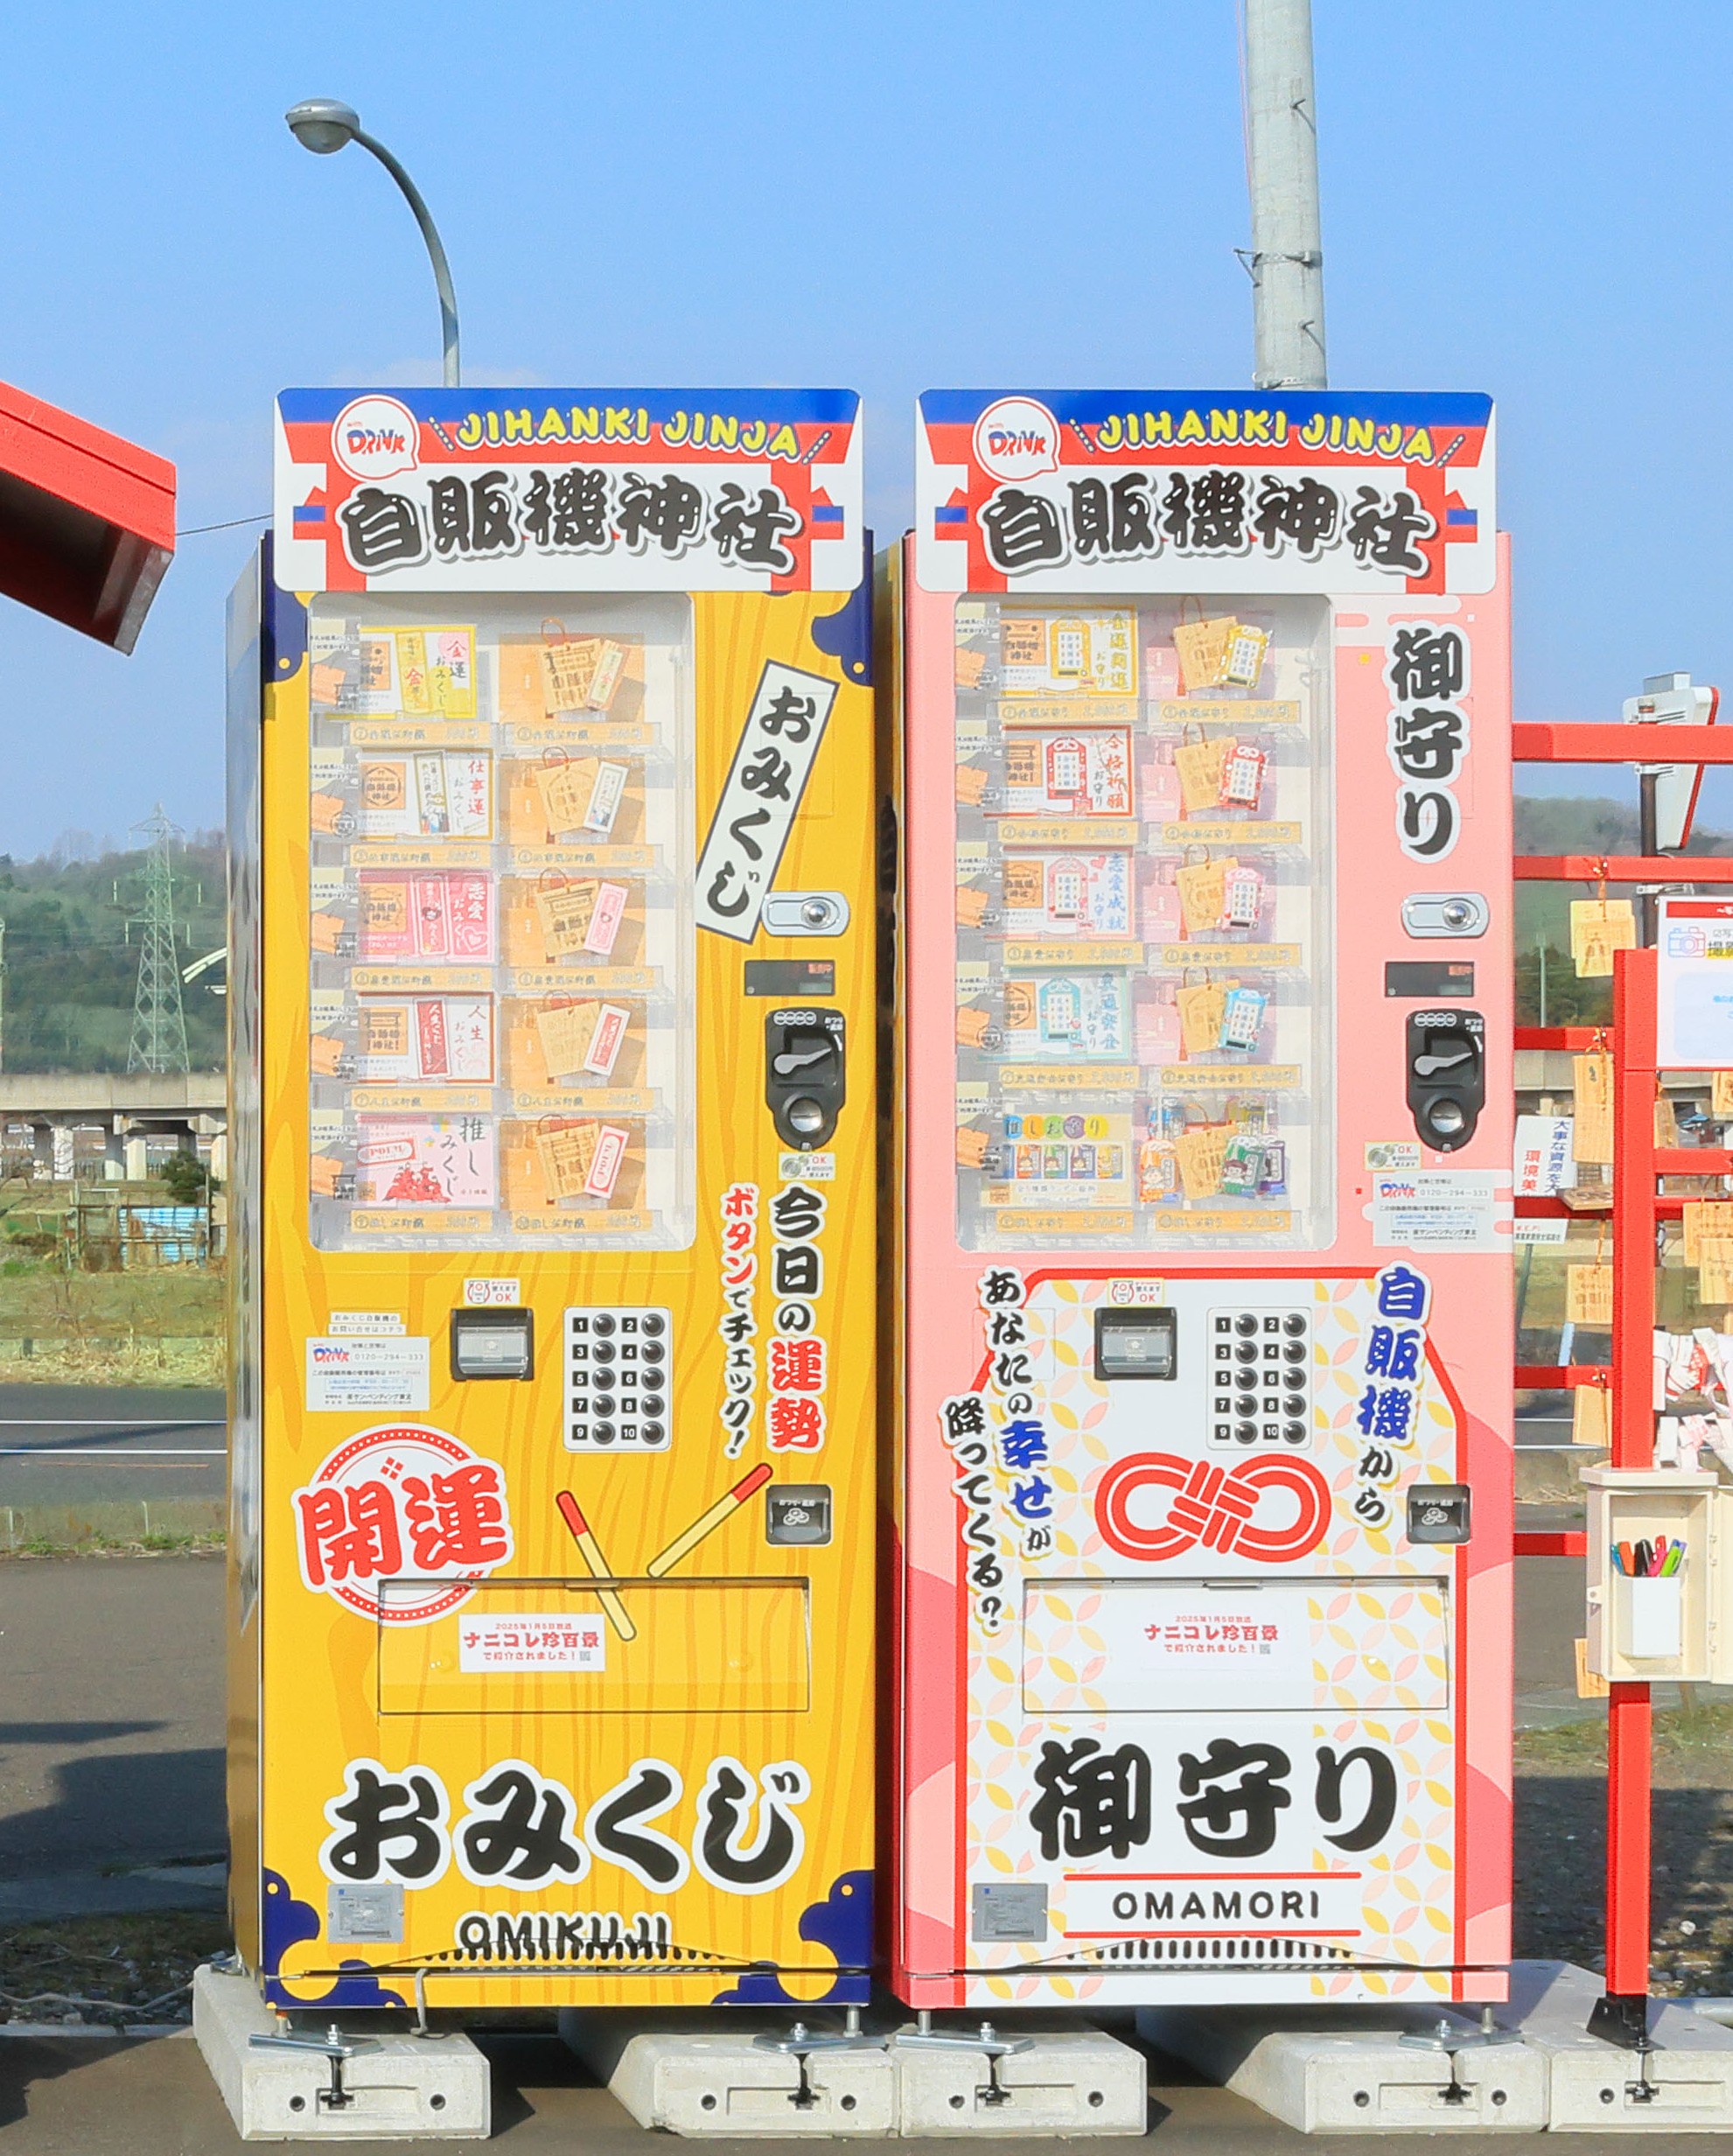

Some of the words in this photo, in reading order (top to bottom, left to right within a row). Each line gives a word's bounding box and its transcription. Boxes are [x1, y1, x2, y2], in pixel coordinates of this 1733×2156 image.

[461, 407, 649, 444] JIHANKI
[663, 412, 799, 458] JINJA
[1098, 409, 1288, 445] JIHANKI
[1300, 414, 1435, 462] JINJA
[345, 467, 798, 570] 自販機神社
[982, 470, 1431, 570] 自販機神社
[446, 640, 468, 680] 金運
[1389, 626, 1464, 857] 御守り
[1105, 732, 1126, 809] 合格祈願
[466, 760, 486, 816] 仕事運
[1093, 770, 1105, 808] お守り
[707, 685, 816, 918] おみくじ
[1107, 852, 1128, 931] 恋愛成就
[466, 881, 486, 922] 恋愛
[467, 1004, 487, 1041] 人生
[458, 1116, 486, 1177] 推し
[1397, 1145, 1413, 1154] OK
[439, 1134, 460, 1198] みくじ
[812, 1155, 827, 1165] OK
[1544, 1119, 1571, 1197] 大事な資源を大
[1520, 1149, 1541, 1197] 環境美
[495, 1292, 513, 1303] OK
[1139, 1293, 1156, 1303] OK
[577, 1320, 584, 1330] 1
[626, 1320, 633, 1331] 2
[771, 1186, 824, 1450] 今日の運勢
[1220, 1320, 1226, 1330] 1
[1268, 1320, 1276, 1329] 2
[577, 1347, 584, 1357] 3
[625, 1347, 633, 1357] 4
[1219, 1348, 1227, 1356] 3
[1268, 1348, 1275, 1356] 4
[577, 1374, 584, 1384] 5
[625, 1374, 633, 1383] 6
[1220, 1374, 1228, 1383] 5
[1268, 1374, 1275, 1383] 6
[1355, 1266, 1427, 1522] 自販機から
[577, 1401, 584, 1410] 7
[625, 1401, 633, 1410] 8
[983, 1269, 1054, 1551] あなたの幸せが
[1219, 1400, 1226, 1410] 7
[1268, 1400, 1275, 1410] 8
[577, 1427, 584, 1438] 9
[623, 1428, 635, 1438] 10
[1219, 1427, 1227, 1437] 9
[1266, 1426, 1279, 1436] 10
[297, 1462, 508, 1586] 開運
[463, 1631, 600, 1648] ナニコレ珍百景
[1143, 1623, 1279, 1642] ナニコレ珍百景
[1029, 1736, 1398, 1862] 御守り
[328, 1768, 802, 1885] おみくじ
[1111, 1888, 1321, 1921] OMAMORI
[459, 1914, 667, 1950] OMIKUJI
